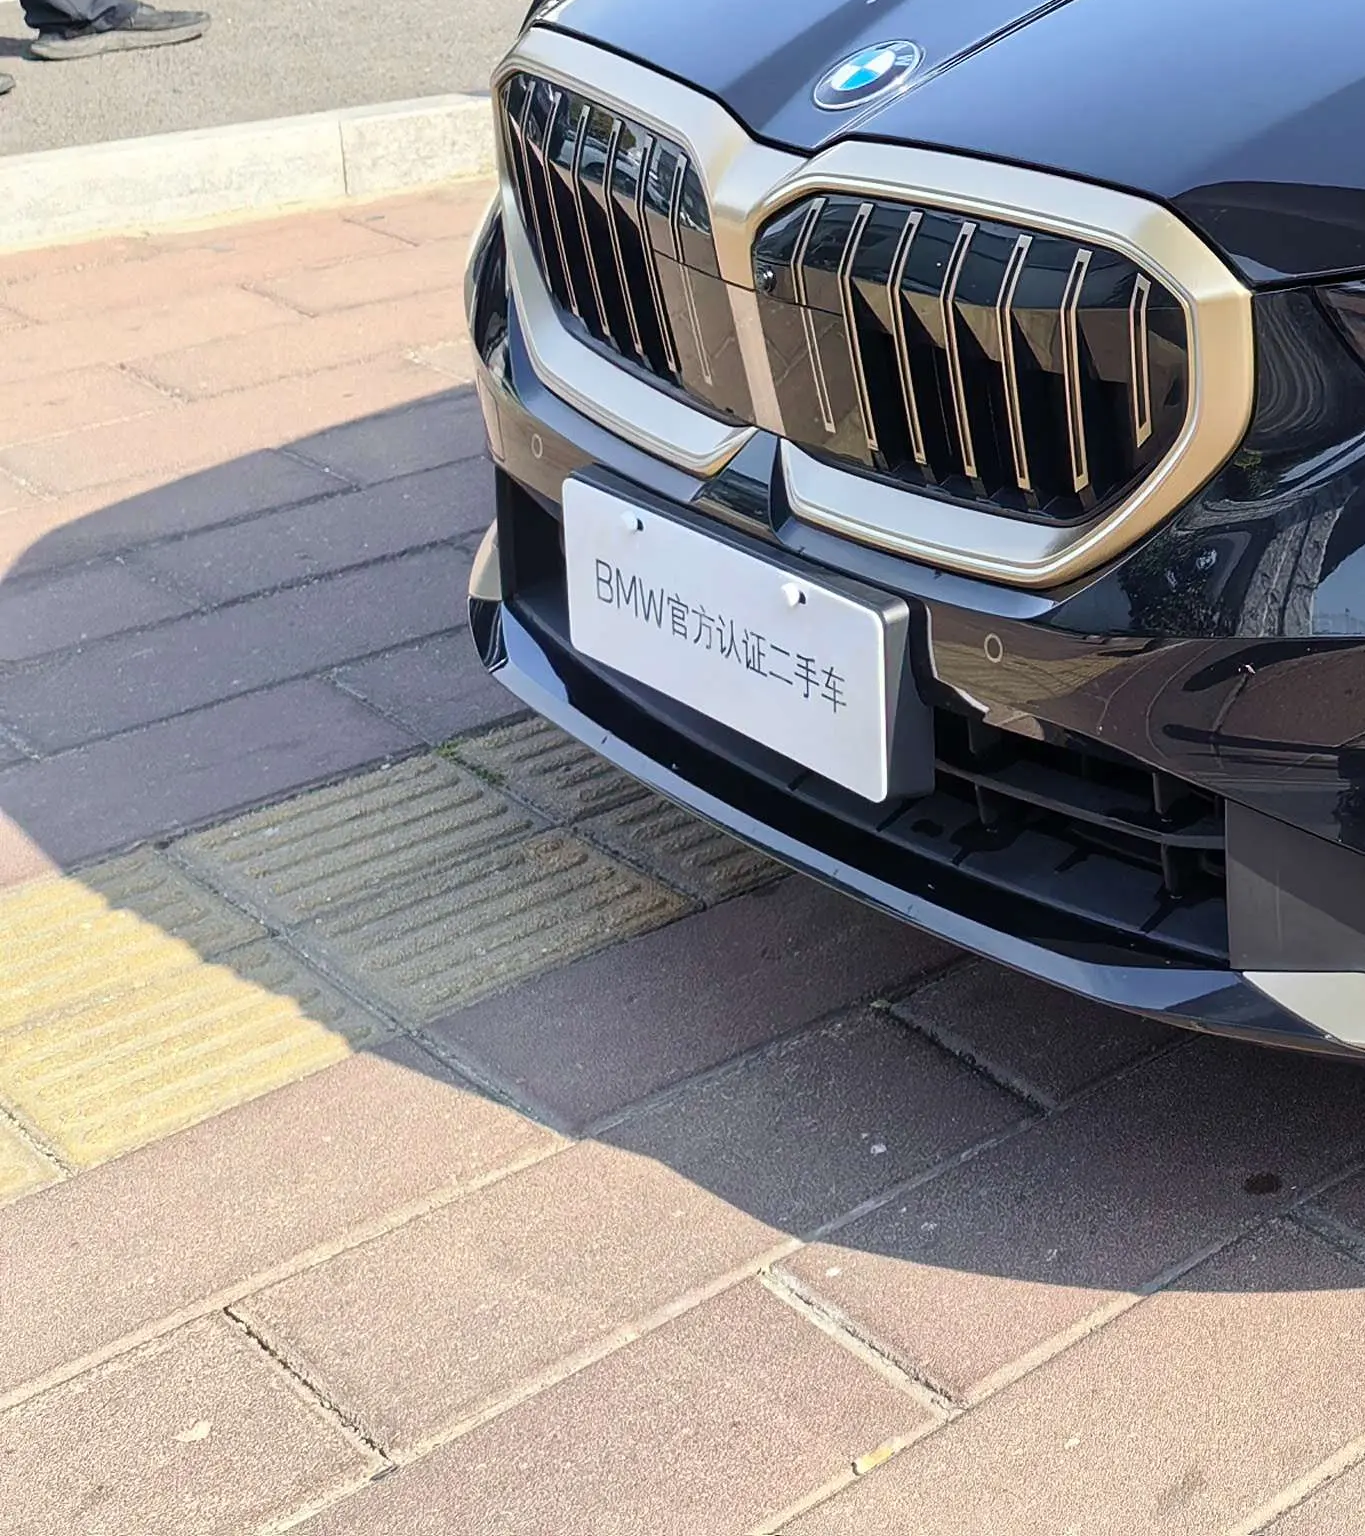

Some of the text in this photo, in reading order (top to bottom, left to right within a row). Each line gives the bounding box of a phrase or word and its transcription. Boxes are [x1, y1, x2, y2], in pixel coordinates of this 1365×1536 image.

[595, 558, 847, 714] BMW官方认证二手车
